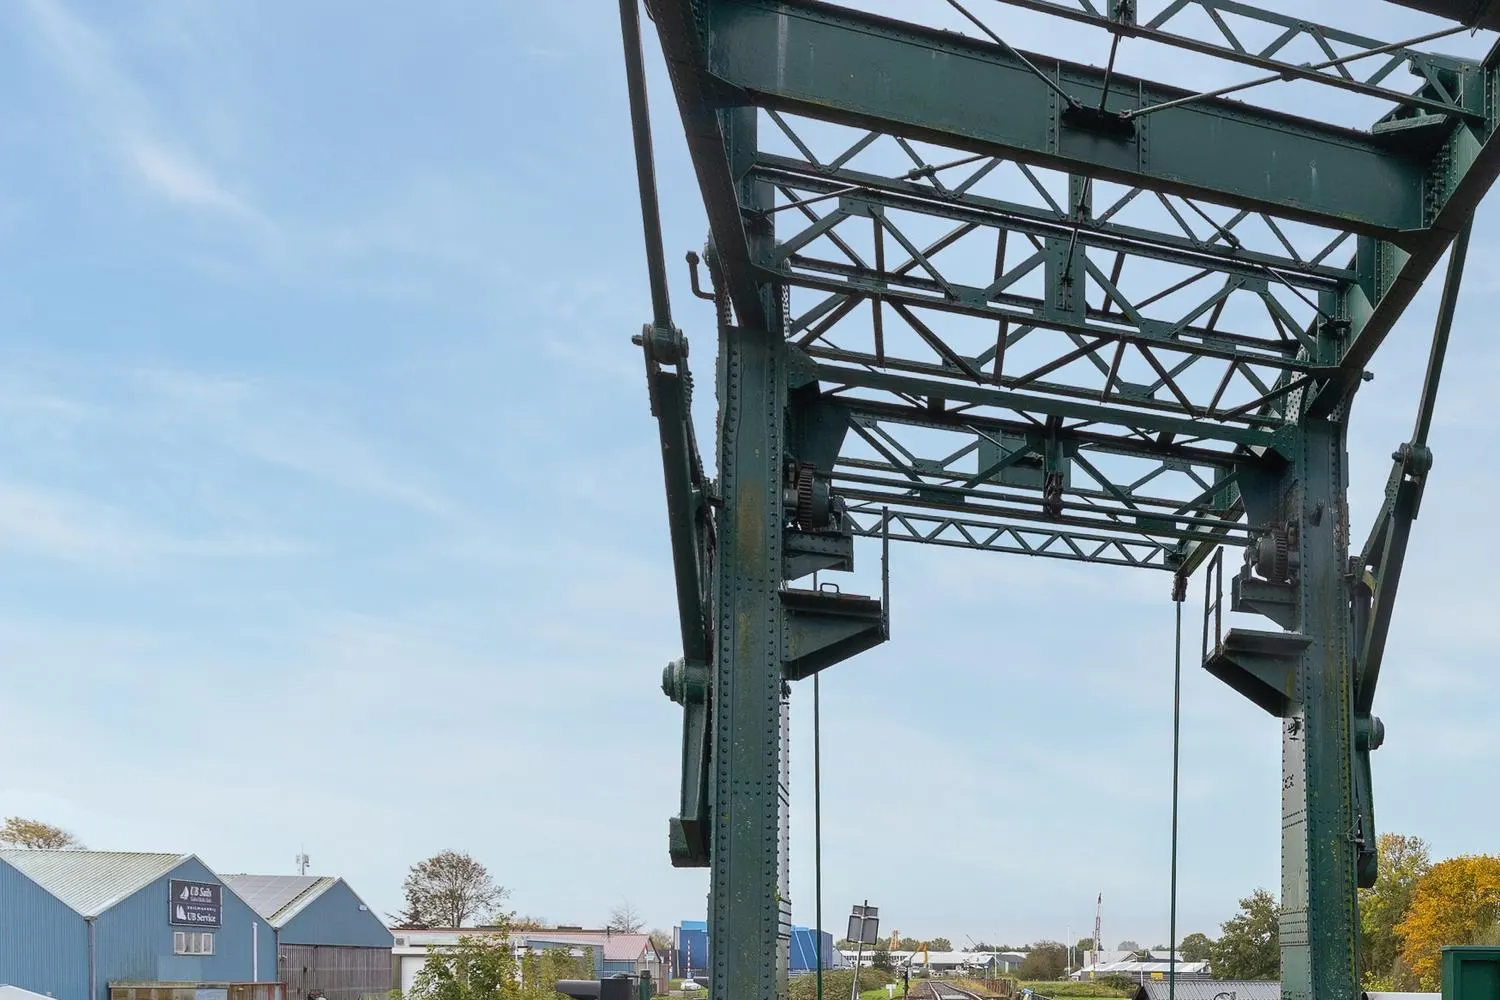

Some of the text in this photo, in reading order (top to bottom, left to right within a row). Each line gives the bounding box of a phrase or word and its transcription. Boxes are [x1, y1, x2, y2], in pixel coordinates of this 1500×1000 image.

[199, 887, 212, 897] Sails
[187, 912, 216, 922] UB Service
